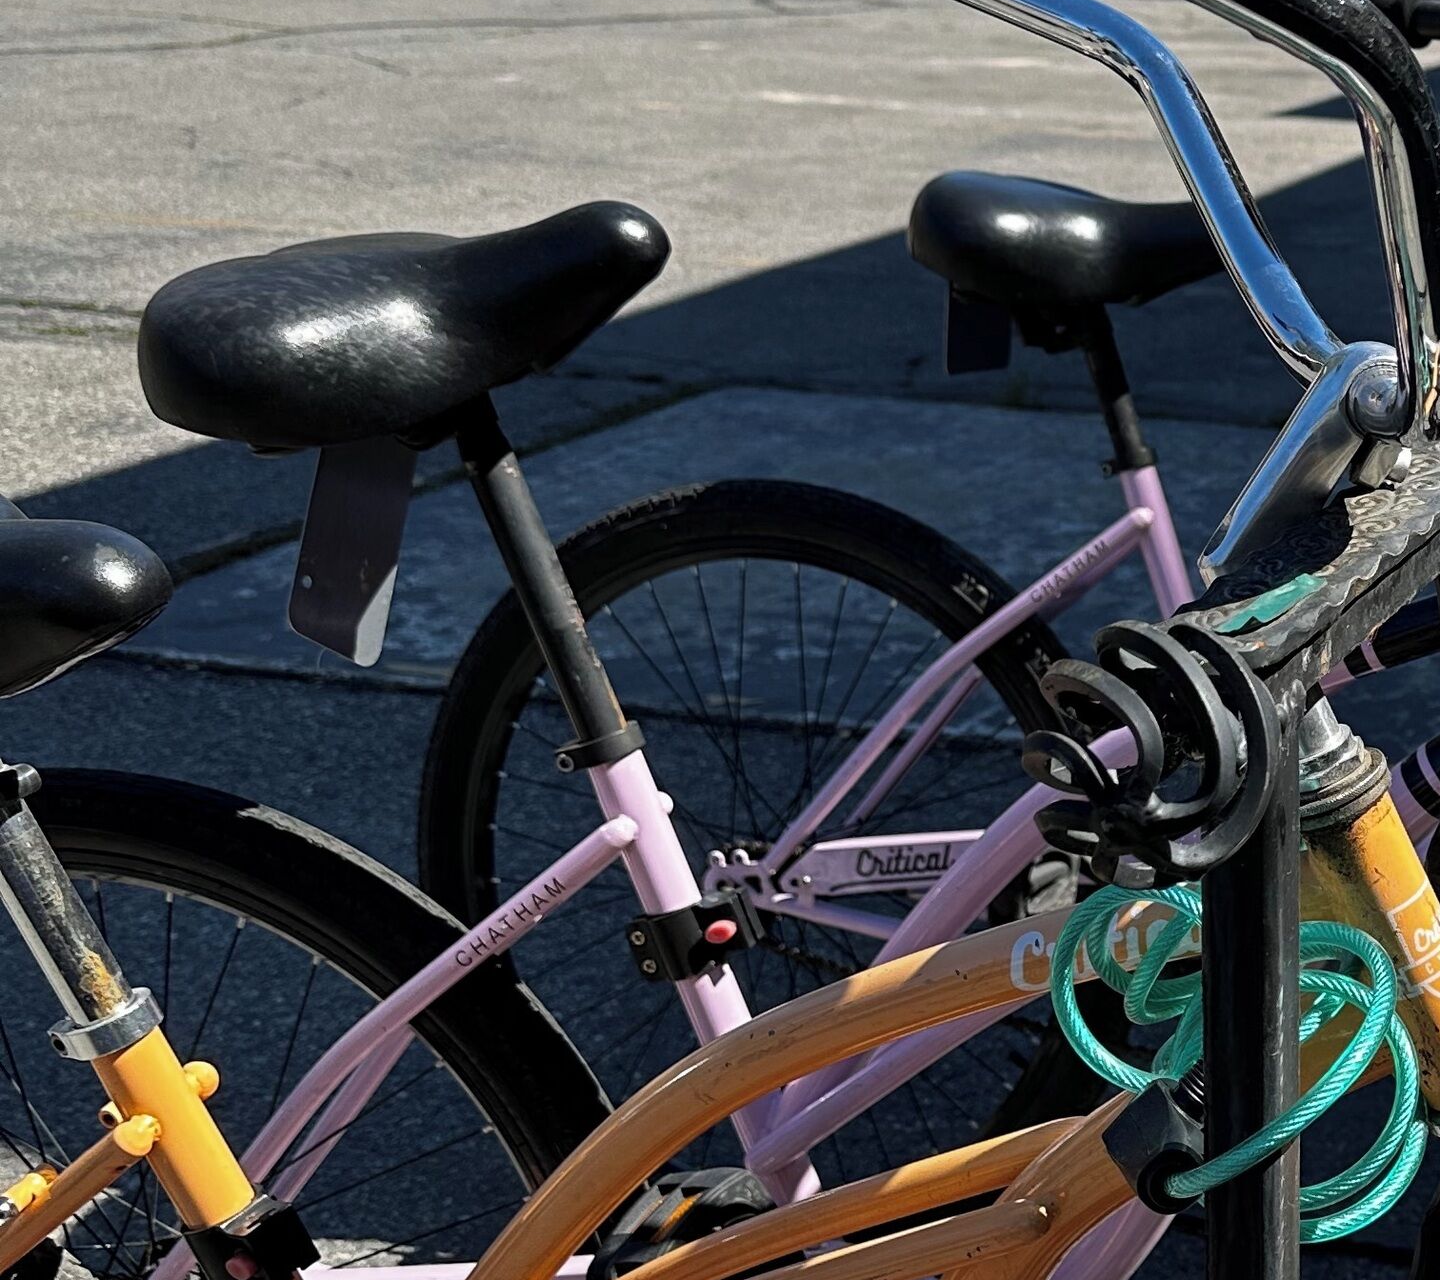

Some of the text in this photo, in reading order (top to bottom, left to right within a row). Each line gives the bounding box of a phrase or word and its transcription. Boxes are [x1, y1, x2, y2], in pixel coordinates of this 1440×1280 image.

[1030, 540, 1110, 603] CHATHAM
[856, 844, 954, 877] Critical
[455, 876, 567, 968] CHATHAM
